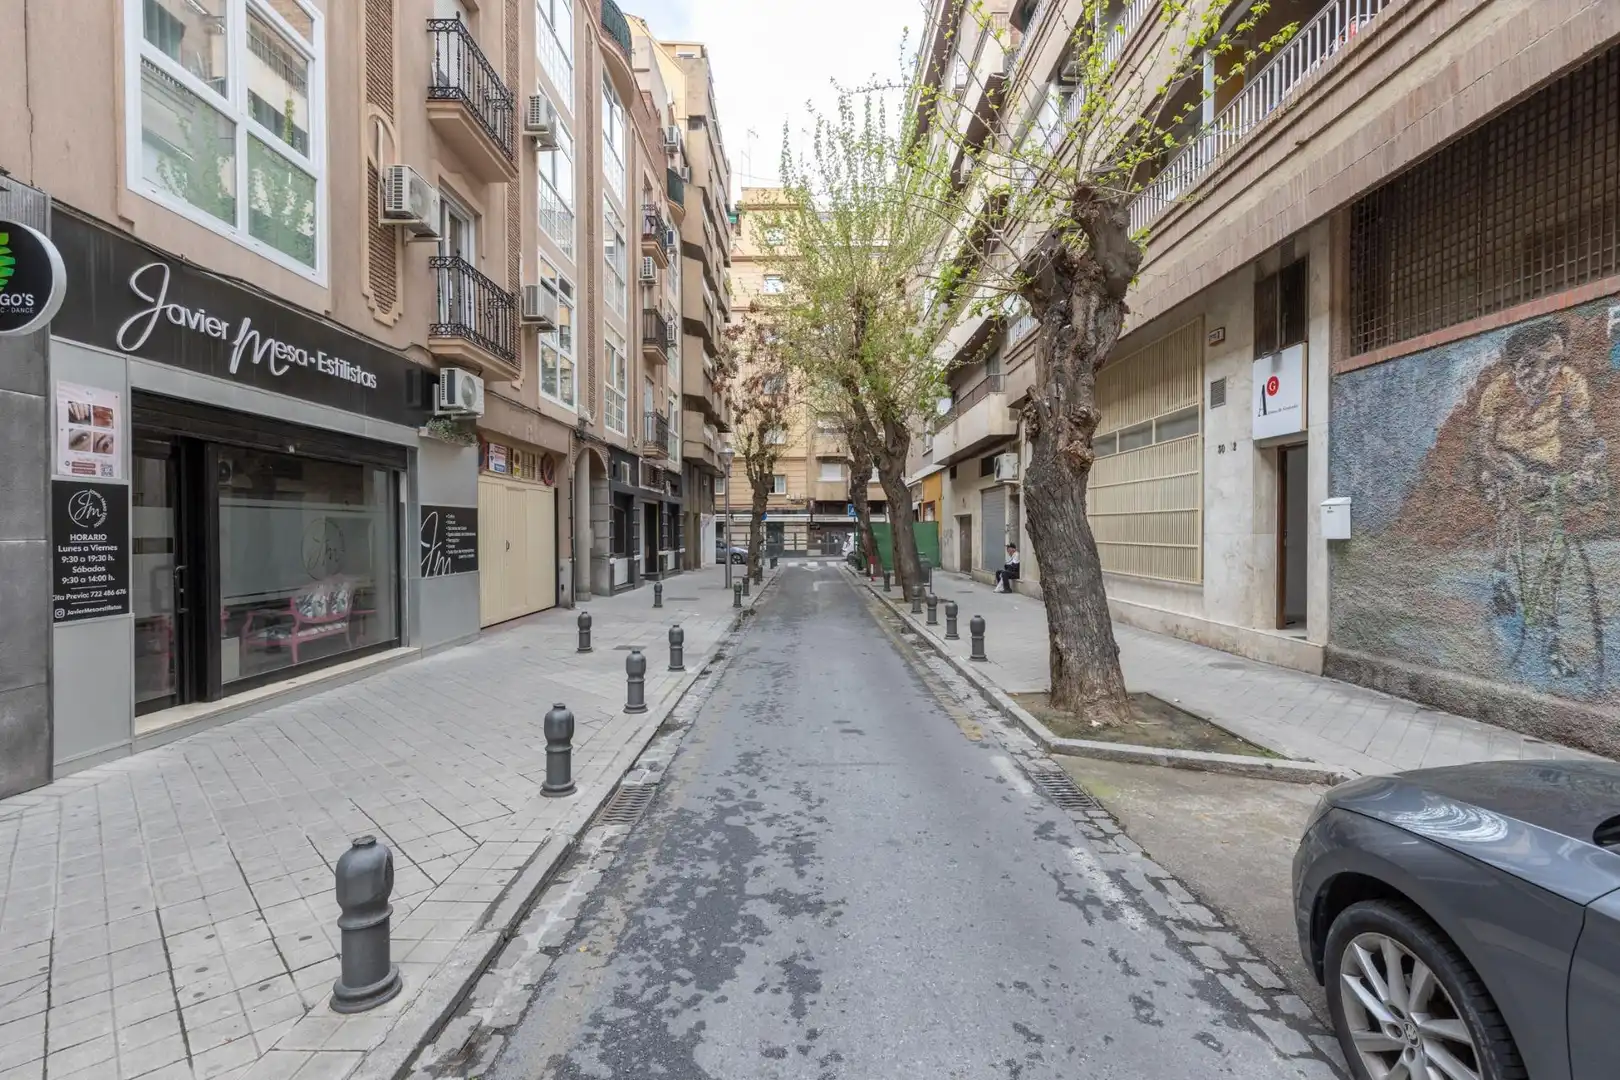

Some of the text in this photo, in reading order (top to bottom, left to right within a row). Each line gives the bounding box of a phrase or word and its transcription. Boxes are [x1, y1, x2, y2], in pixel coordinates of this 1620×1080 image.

[116, 262, 378, 389] Javier Mesa Estilistas
[70, 533, 107, 541] HORARIO
[58, 545, 82, 553] Lunes
[90, 544, 118, 552] Viernes
[61, 555, 79, 563] 9:30
[88, 554, 107, 562] 19:30
[108, 553, 115, 561] h.
[72, 565, 106, 573] Sábados
[62, 576, 79, 584] 9:30
[88, 575, 107, 583] 14:00
[90, 590, 103, 598] 722
